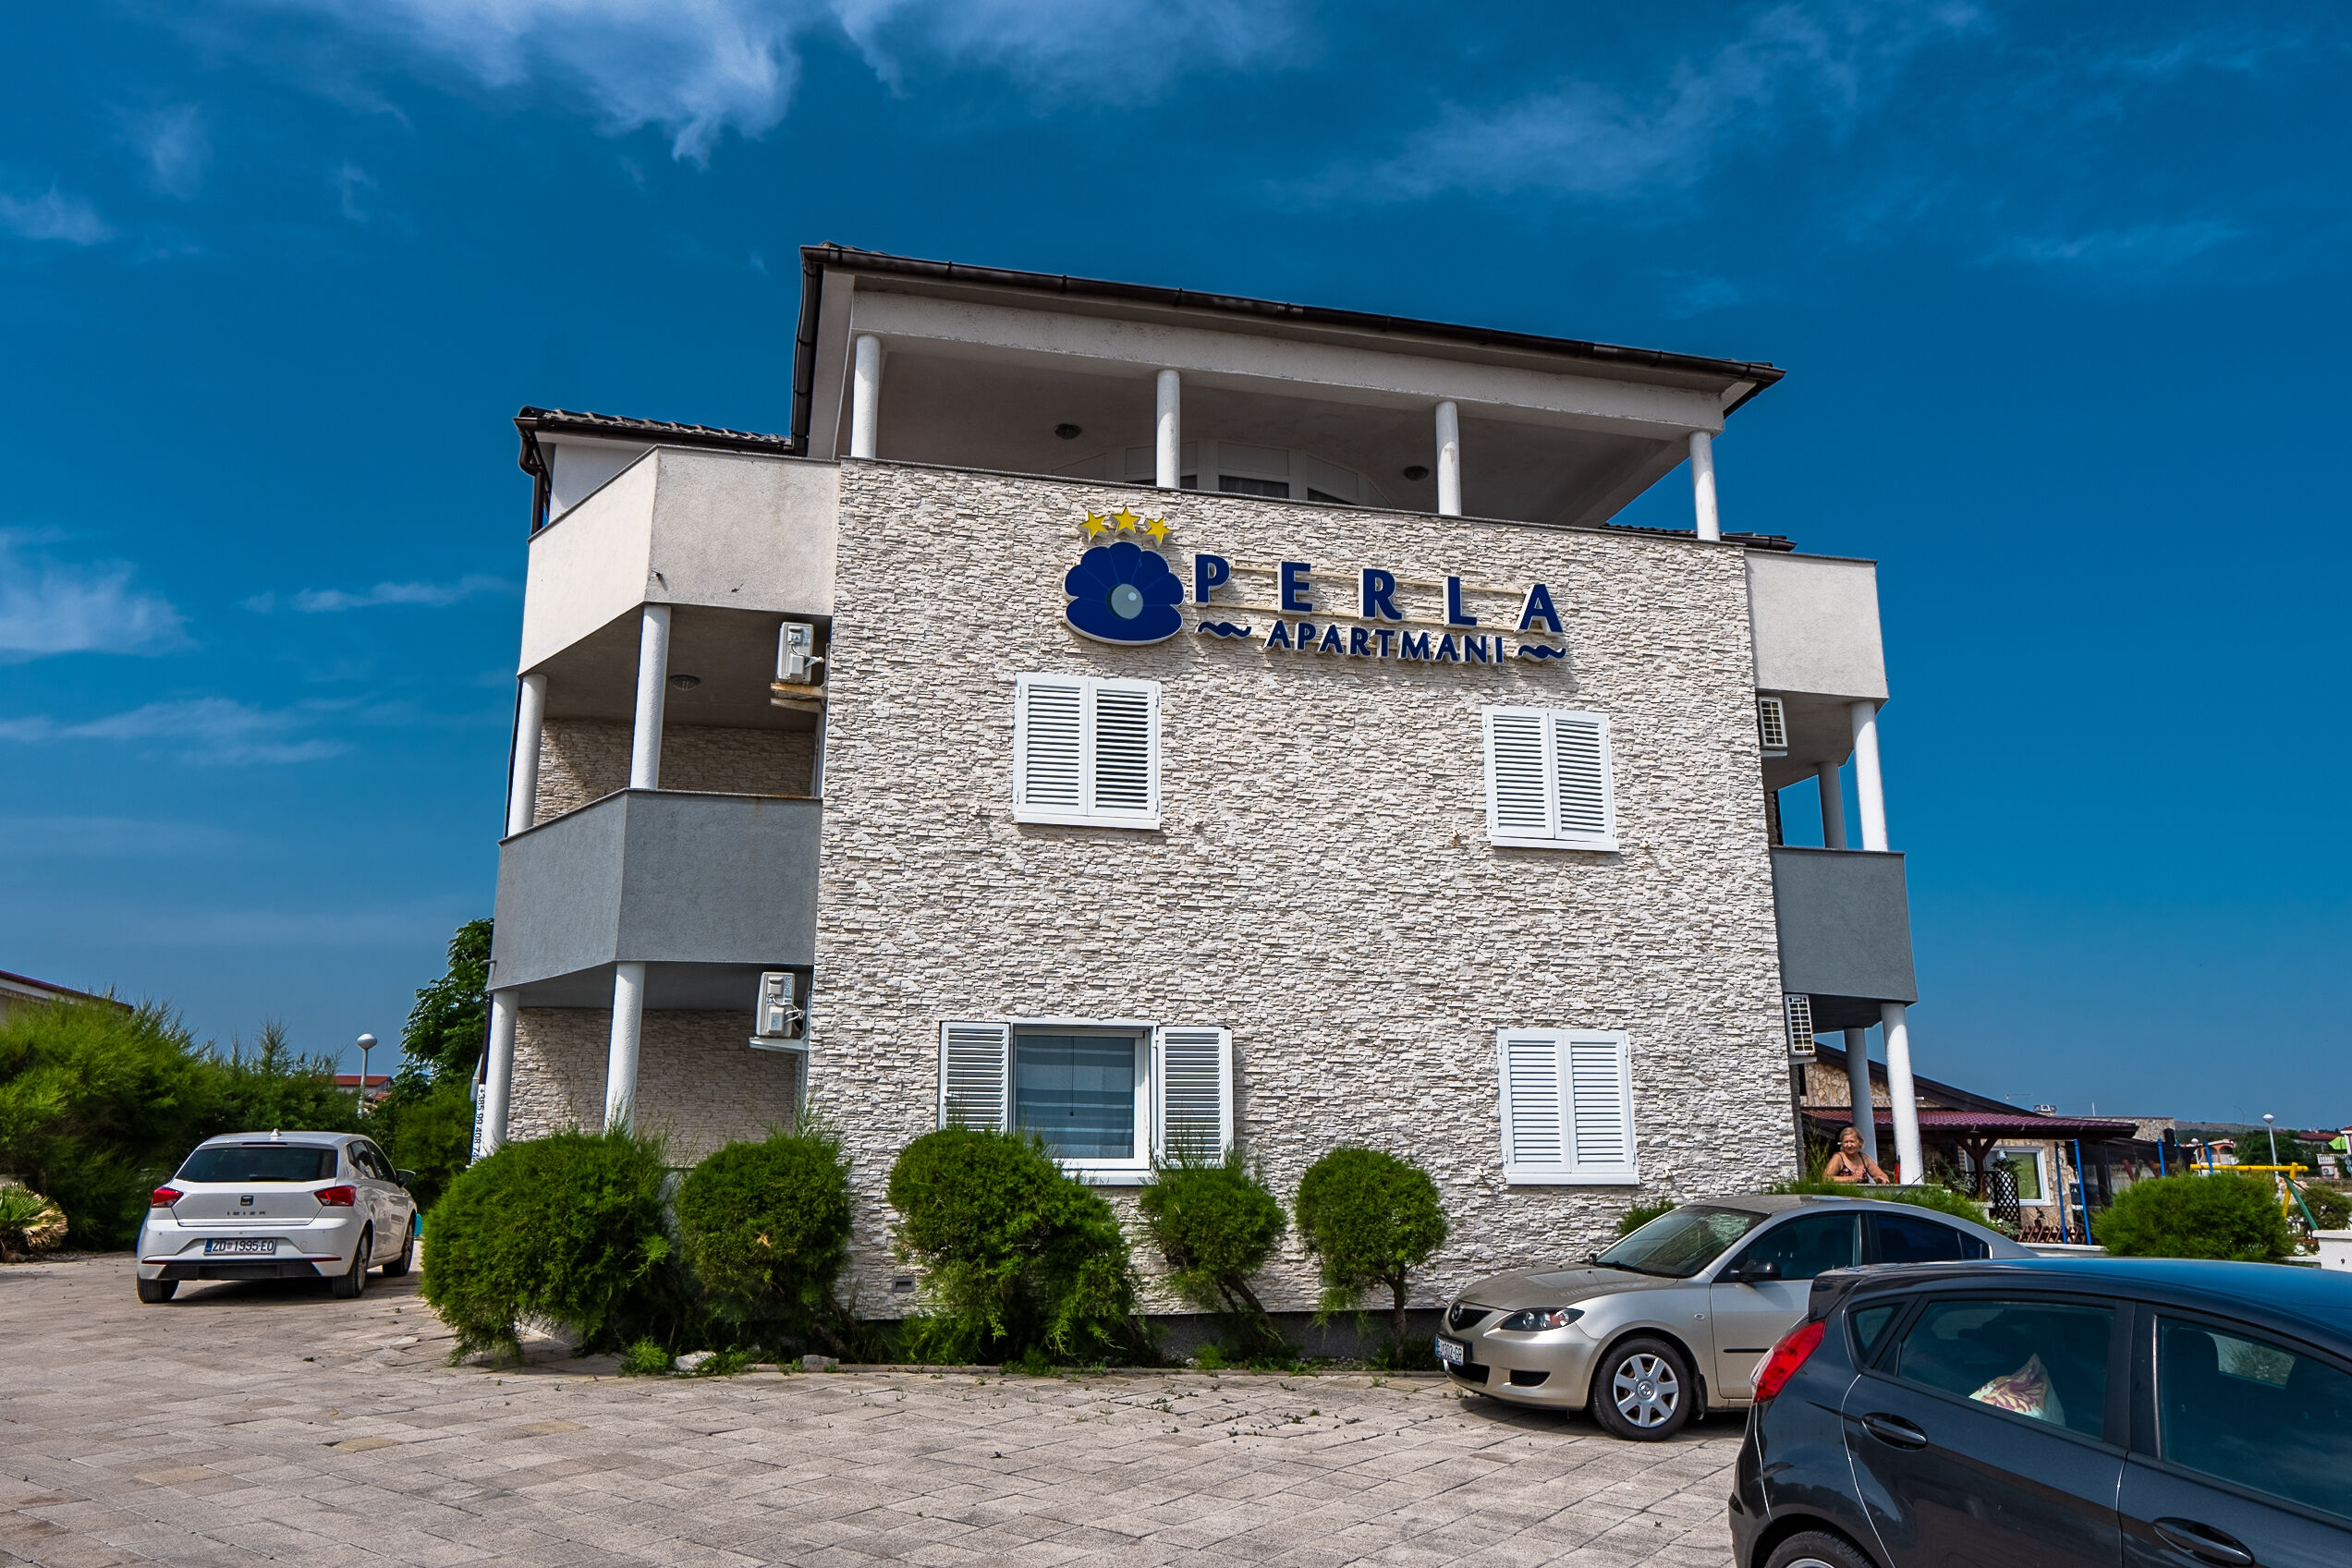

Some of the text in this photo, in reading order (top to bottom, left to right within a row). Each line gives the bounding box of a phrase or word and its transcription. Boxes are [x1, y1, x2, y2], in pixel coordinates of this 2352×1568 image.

[1194, 553, 1564, 634] PERLA
[1264, 619, 1504, 664] APARTMANI
[476, 1112, 484, 1124] 99
